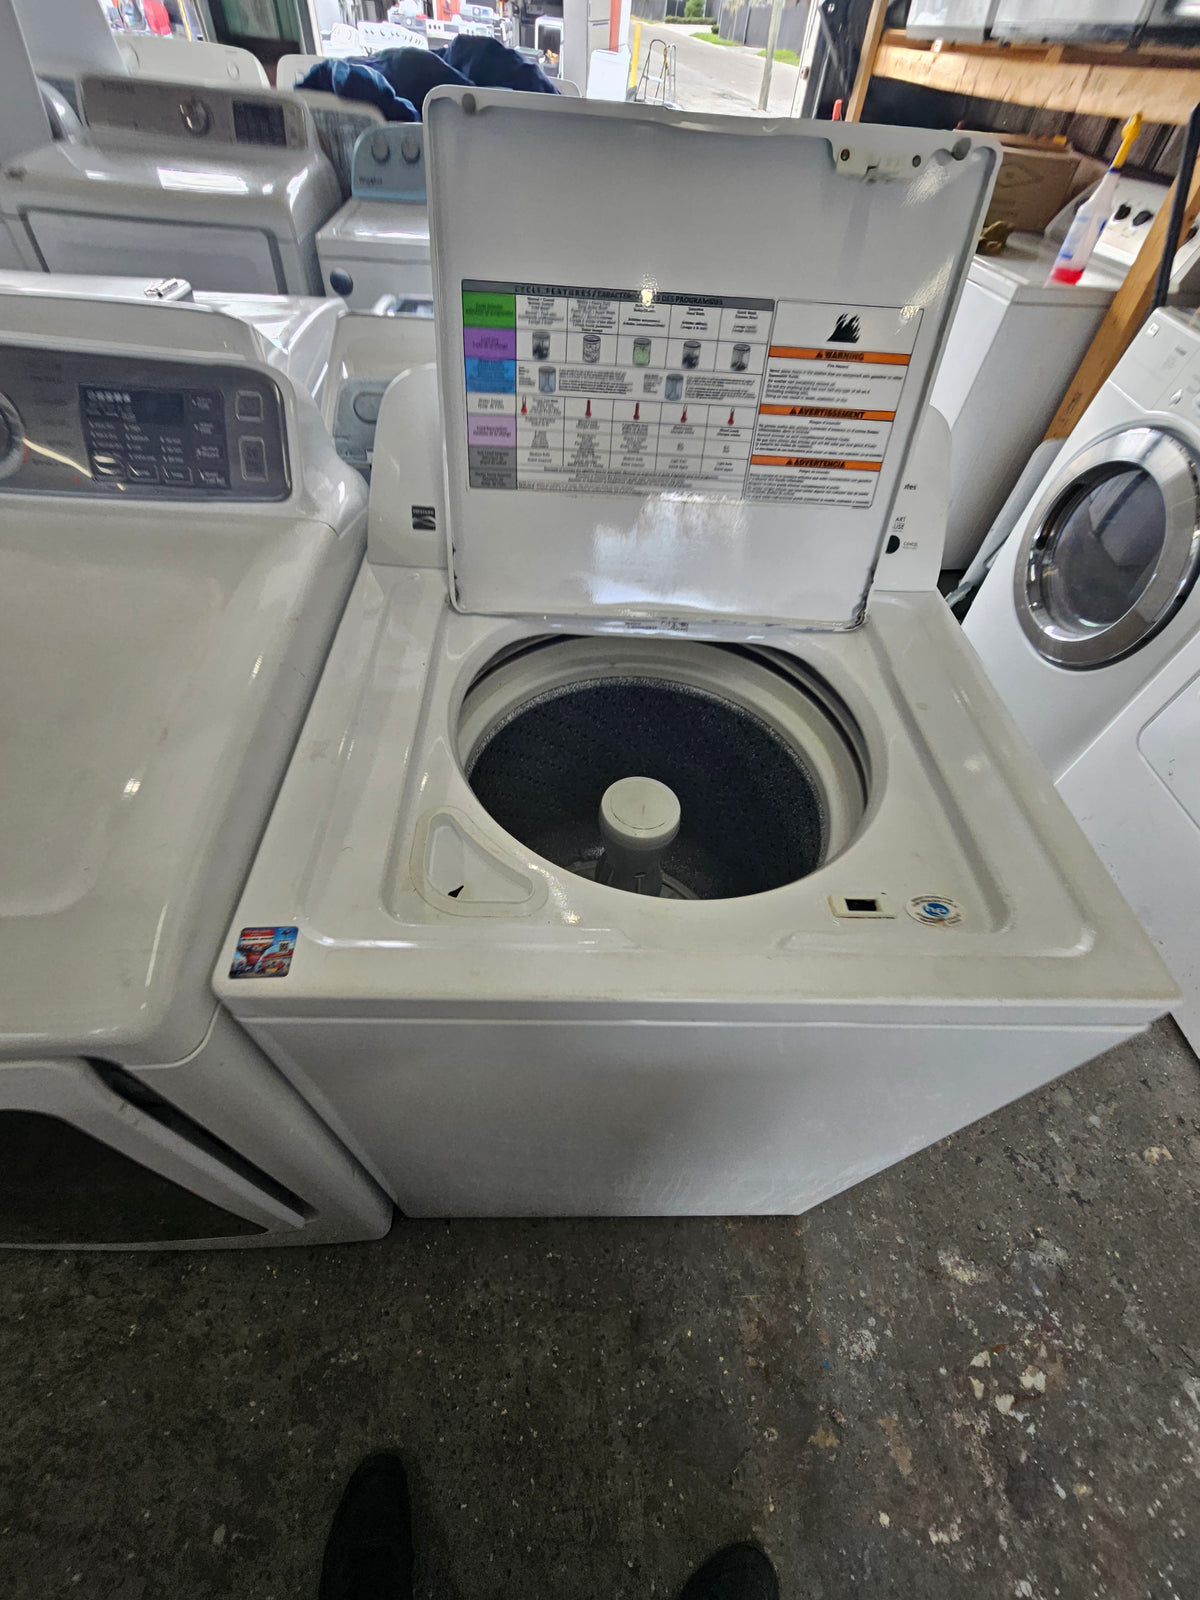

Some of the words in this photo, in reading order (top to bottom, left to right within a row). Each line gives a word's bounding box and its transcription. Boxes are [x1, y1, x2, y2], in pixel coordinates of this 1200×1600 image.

[825, 351, 864, 361] WARNING
[798, 407, 866, 419] AVERTISSEMENT
[794, 458, 846, 469] ADVERTENCIA
